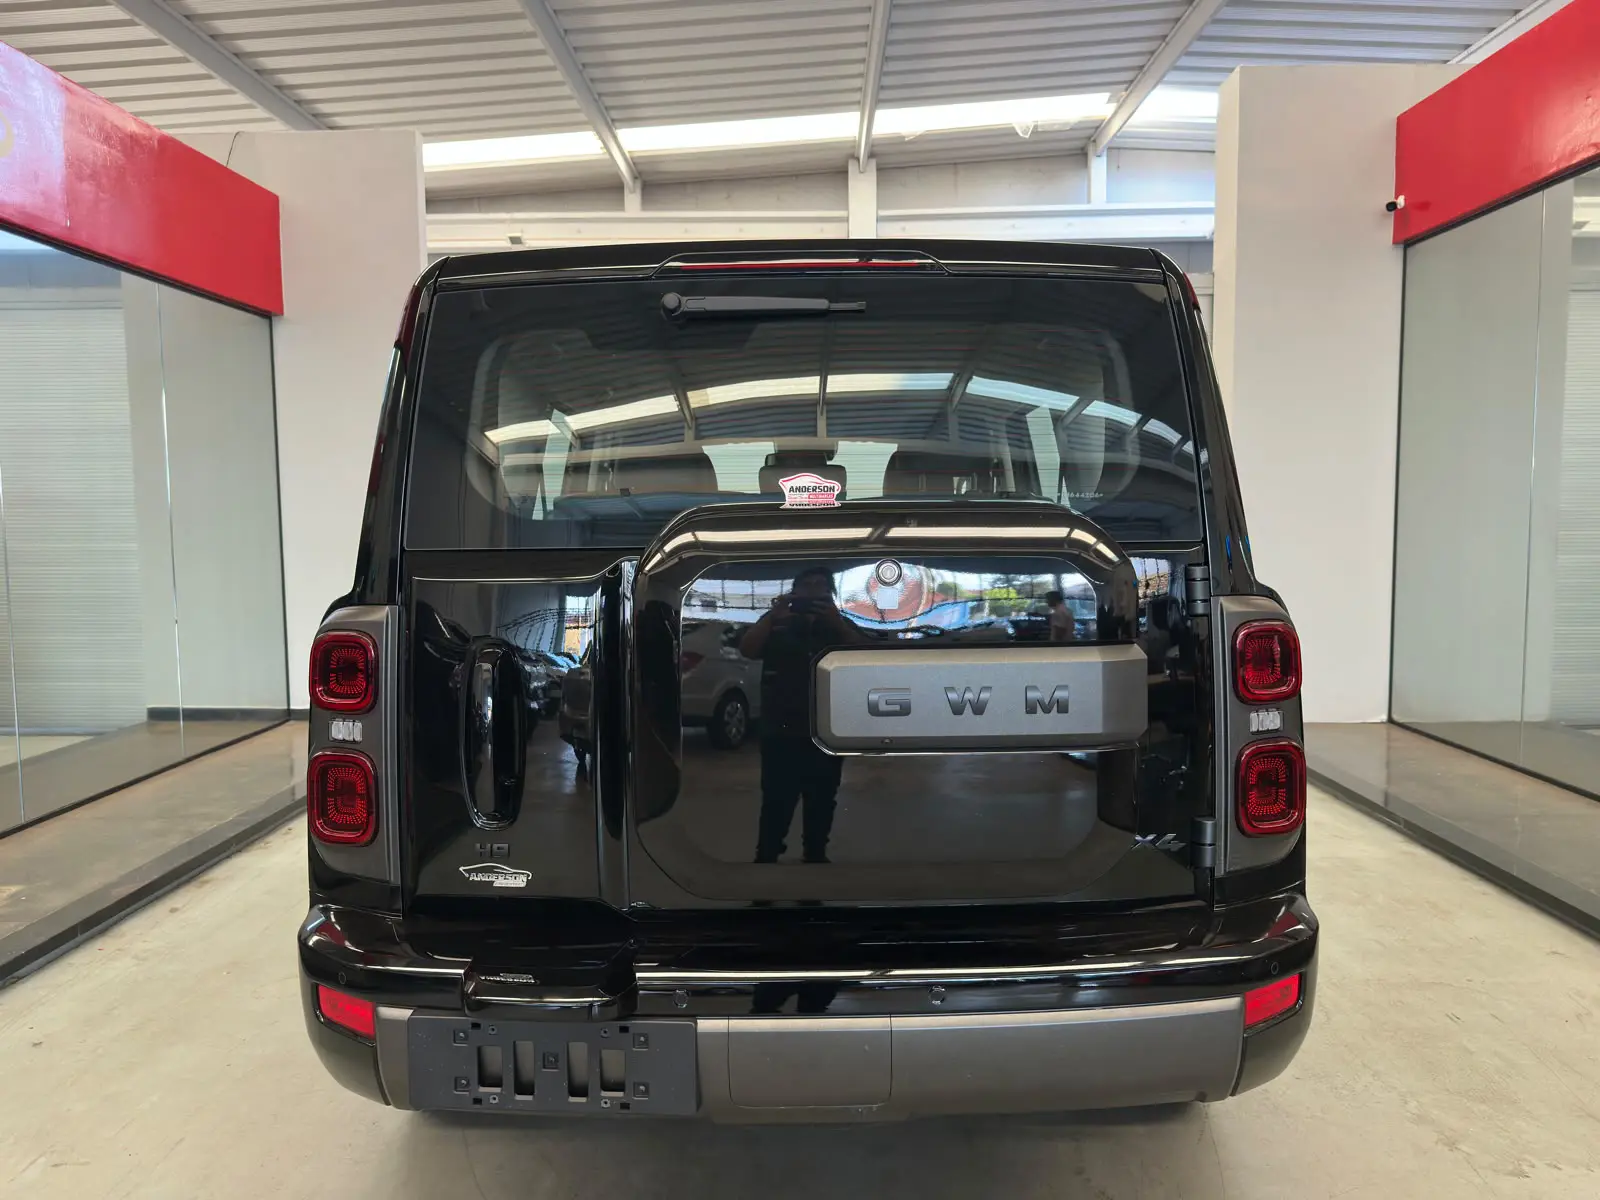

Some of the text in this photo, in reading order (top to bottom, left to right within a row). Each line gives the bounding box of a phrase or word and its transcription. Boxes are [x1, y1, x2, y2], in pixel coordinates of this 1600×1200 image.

[788, 485, 836, 494] ANDERSON
[1130, 833, 1187, 852] X4
[475, 843, 510, 858] H9
[469, 872, 528, 883] ANDERSON
